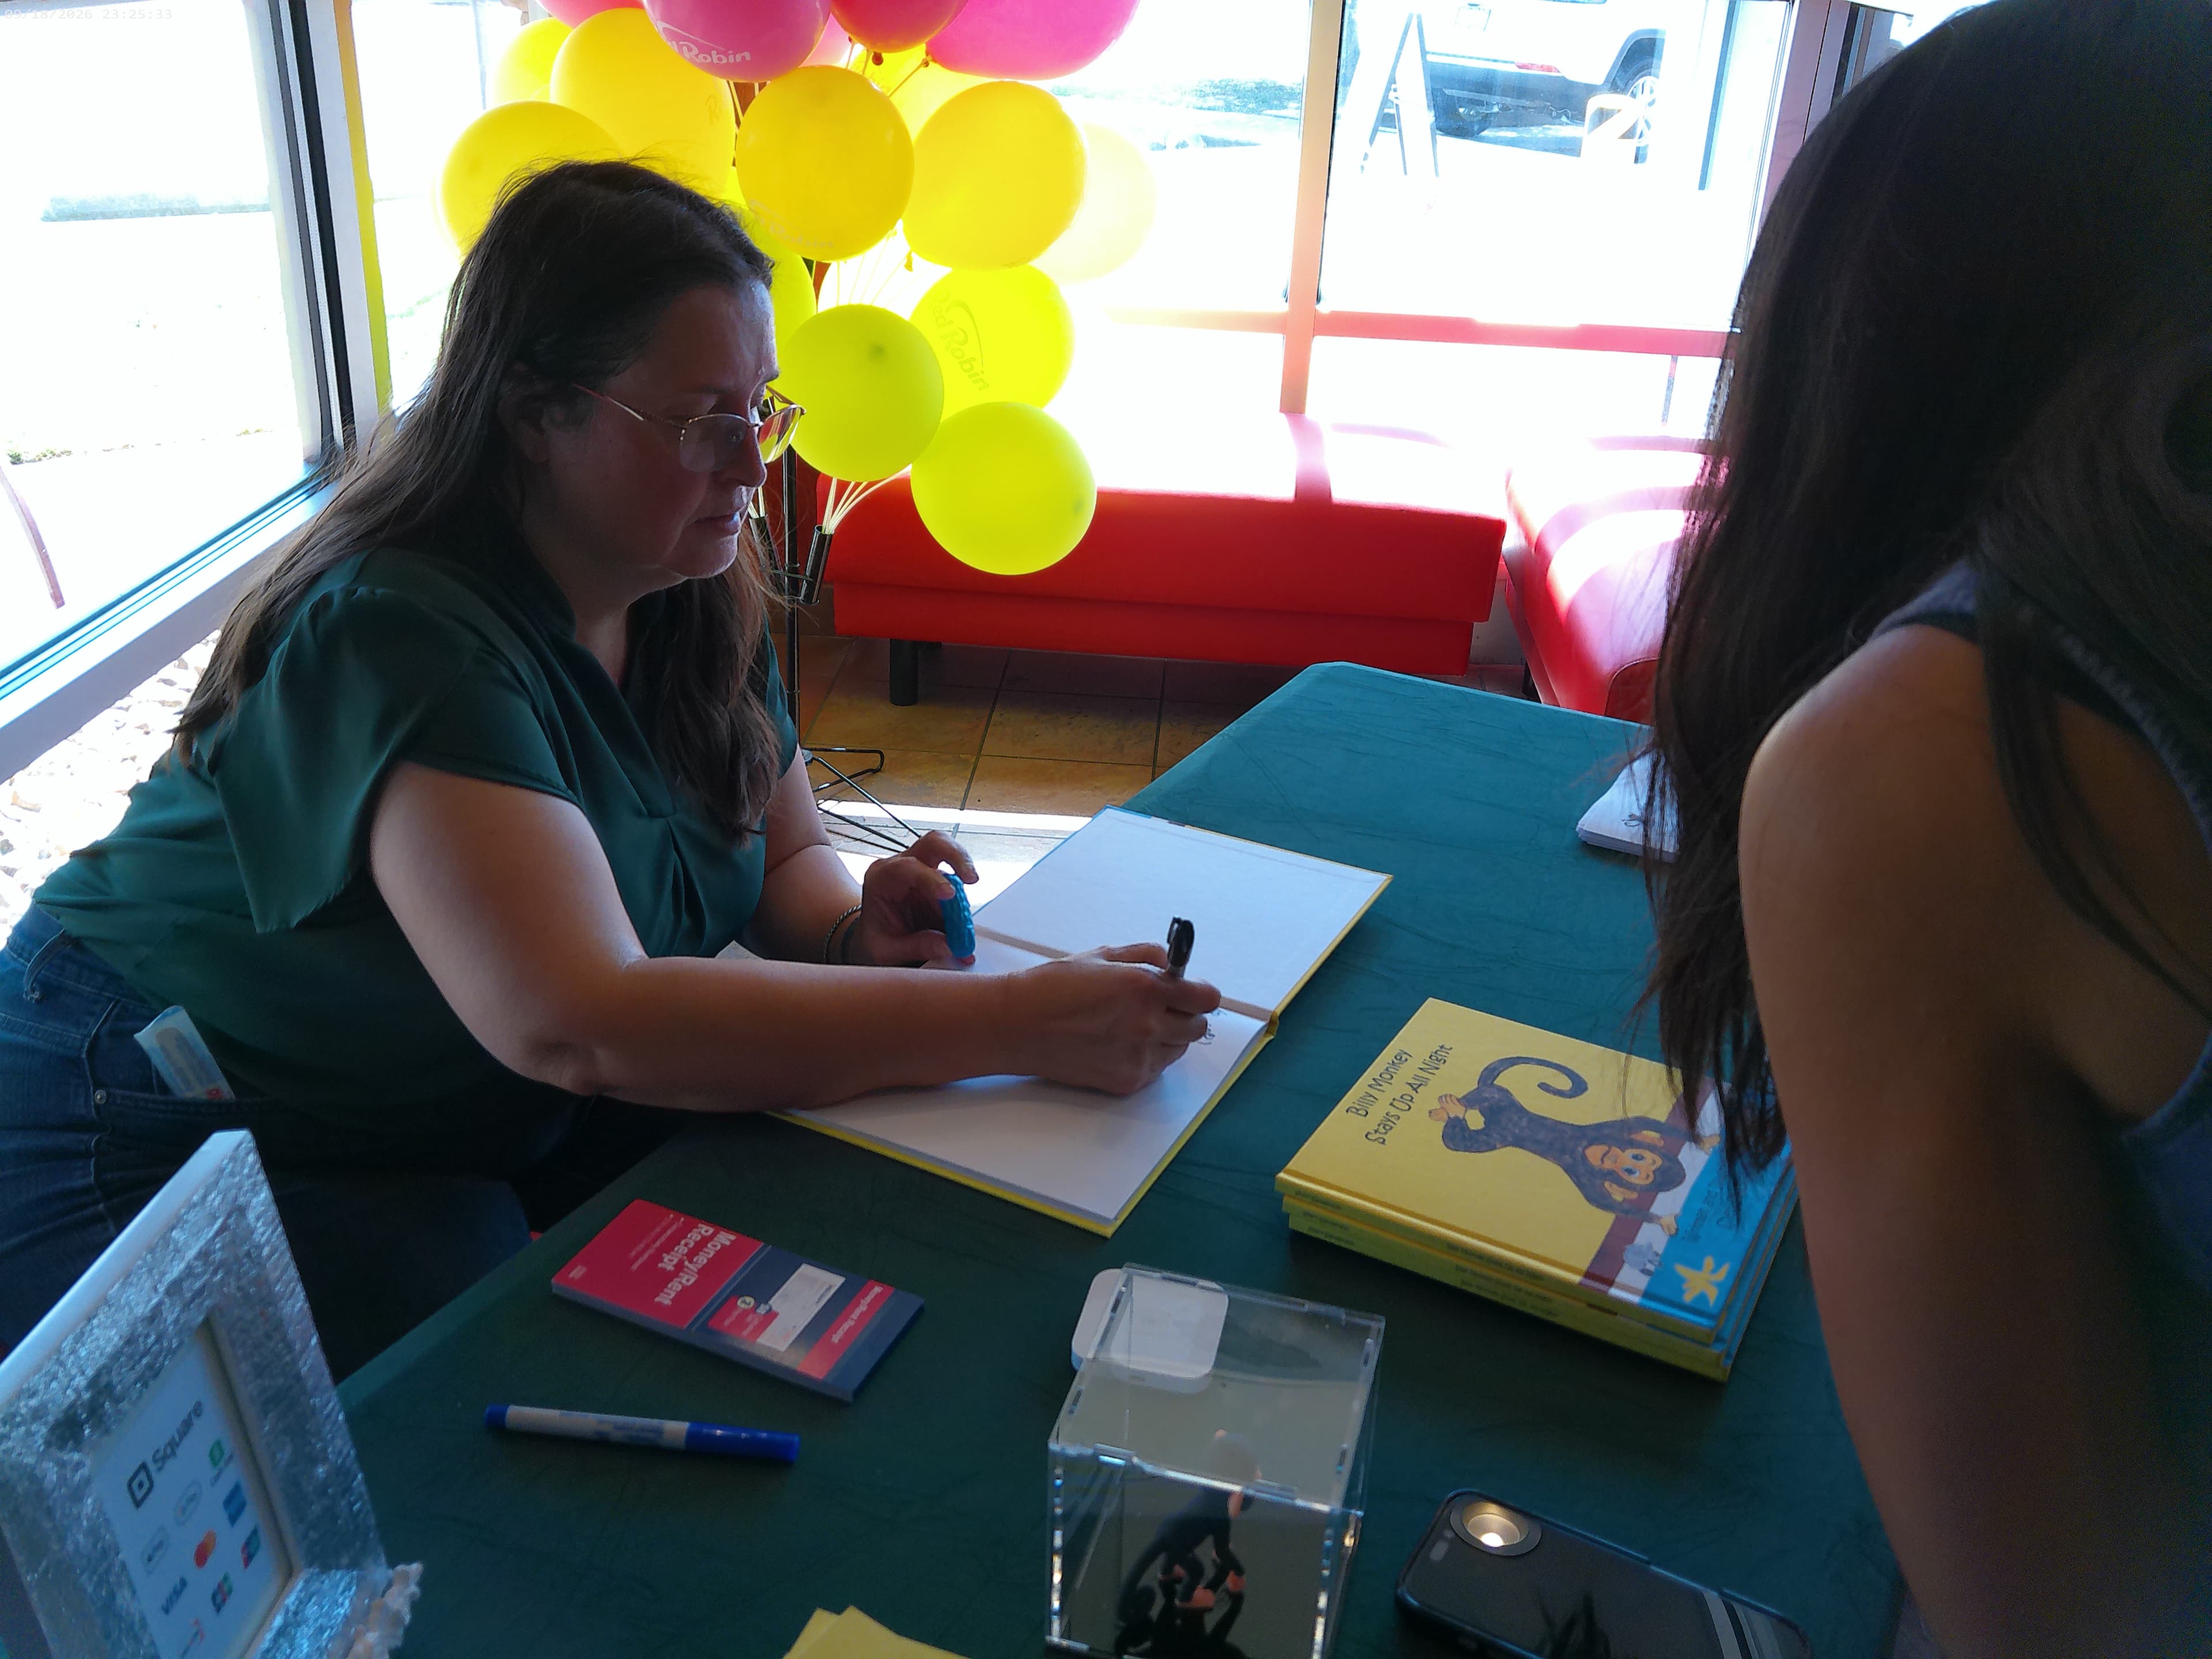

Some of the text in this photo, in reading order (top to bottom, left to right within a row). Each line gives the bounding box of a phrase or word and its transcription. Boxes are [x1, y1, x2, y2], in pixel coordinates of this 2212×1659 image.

[679, 41, 751, 63] Robin
[940, 327, 990, 391] Robin
[1346, 1049, 1413, 1118] Billy Monkey
[1365, 1044, 1453, 1146] Stays Up All Night
[654, 1230, 737, 1305] Money/Rent
[658, 1223, 715, 1271] Receipt
[152, 1400, 203, 1474] Square
